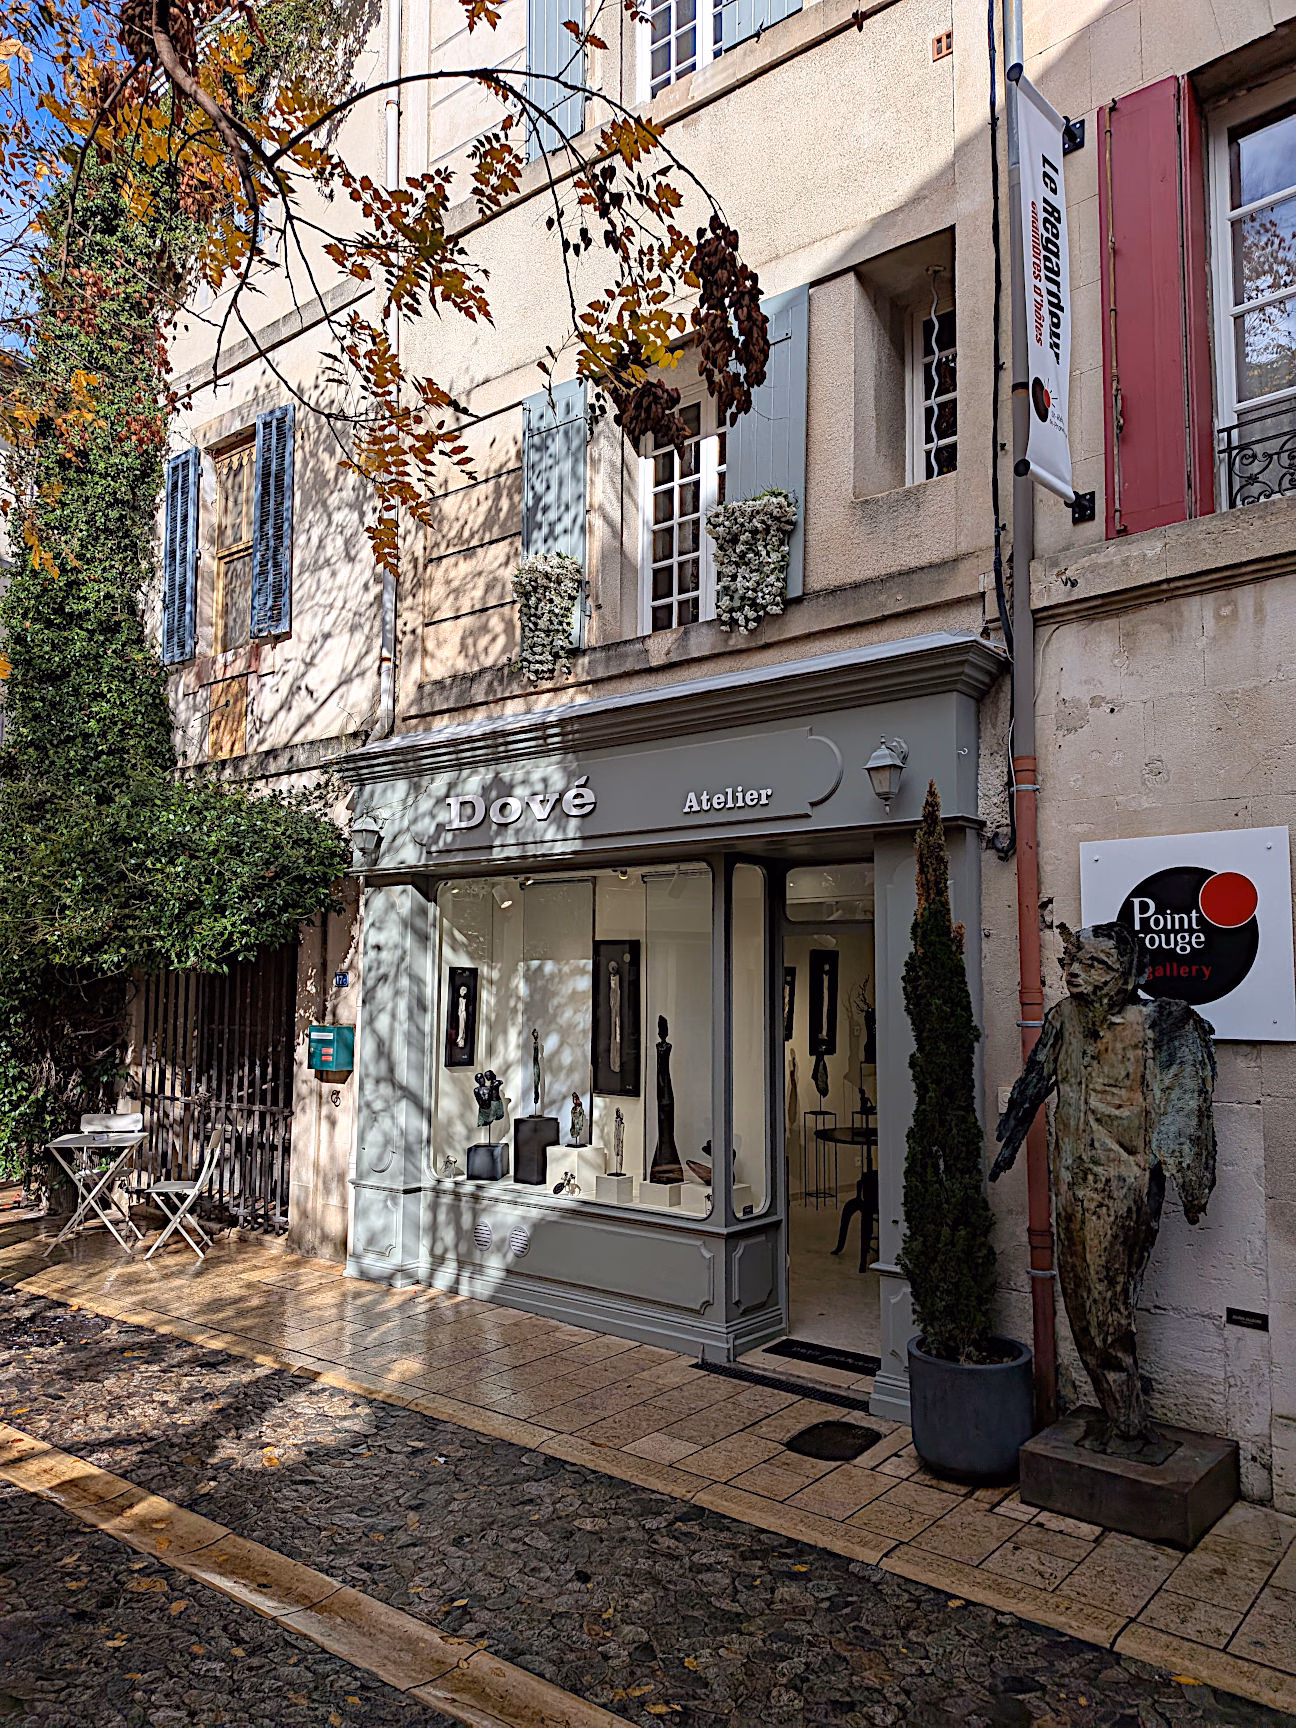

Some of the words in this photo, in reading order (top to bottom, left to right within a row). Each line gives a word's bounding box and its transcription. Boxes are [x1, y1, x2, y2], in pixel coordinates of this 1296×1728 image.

[1041, 153, 1059, 195] Le
[1041, 196, 1064, 365] Regardeur
[1033, 284, 1045, 347] d'hôtes
[445, 775, 597, 830] Dové
[682, 786, 773, 814] Atelier
[1129, 897, 1201, 931] Point
